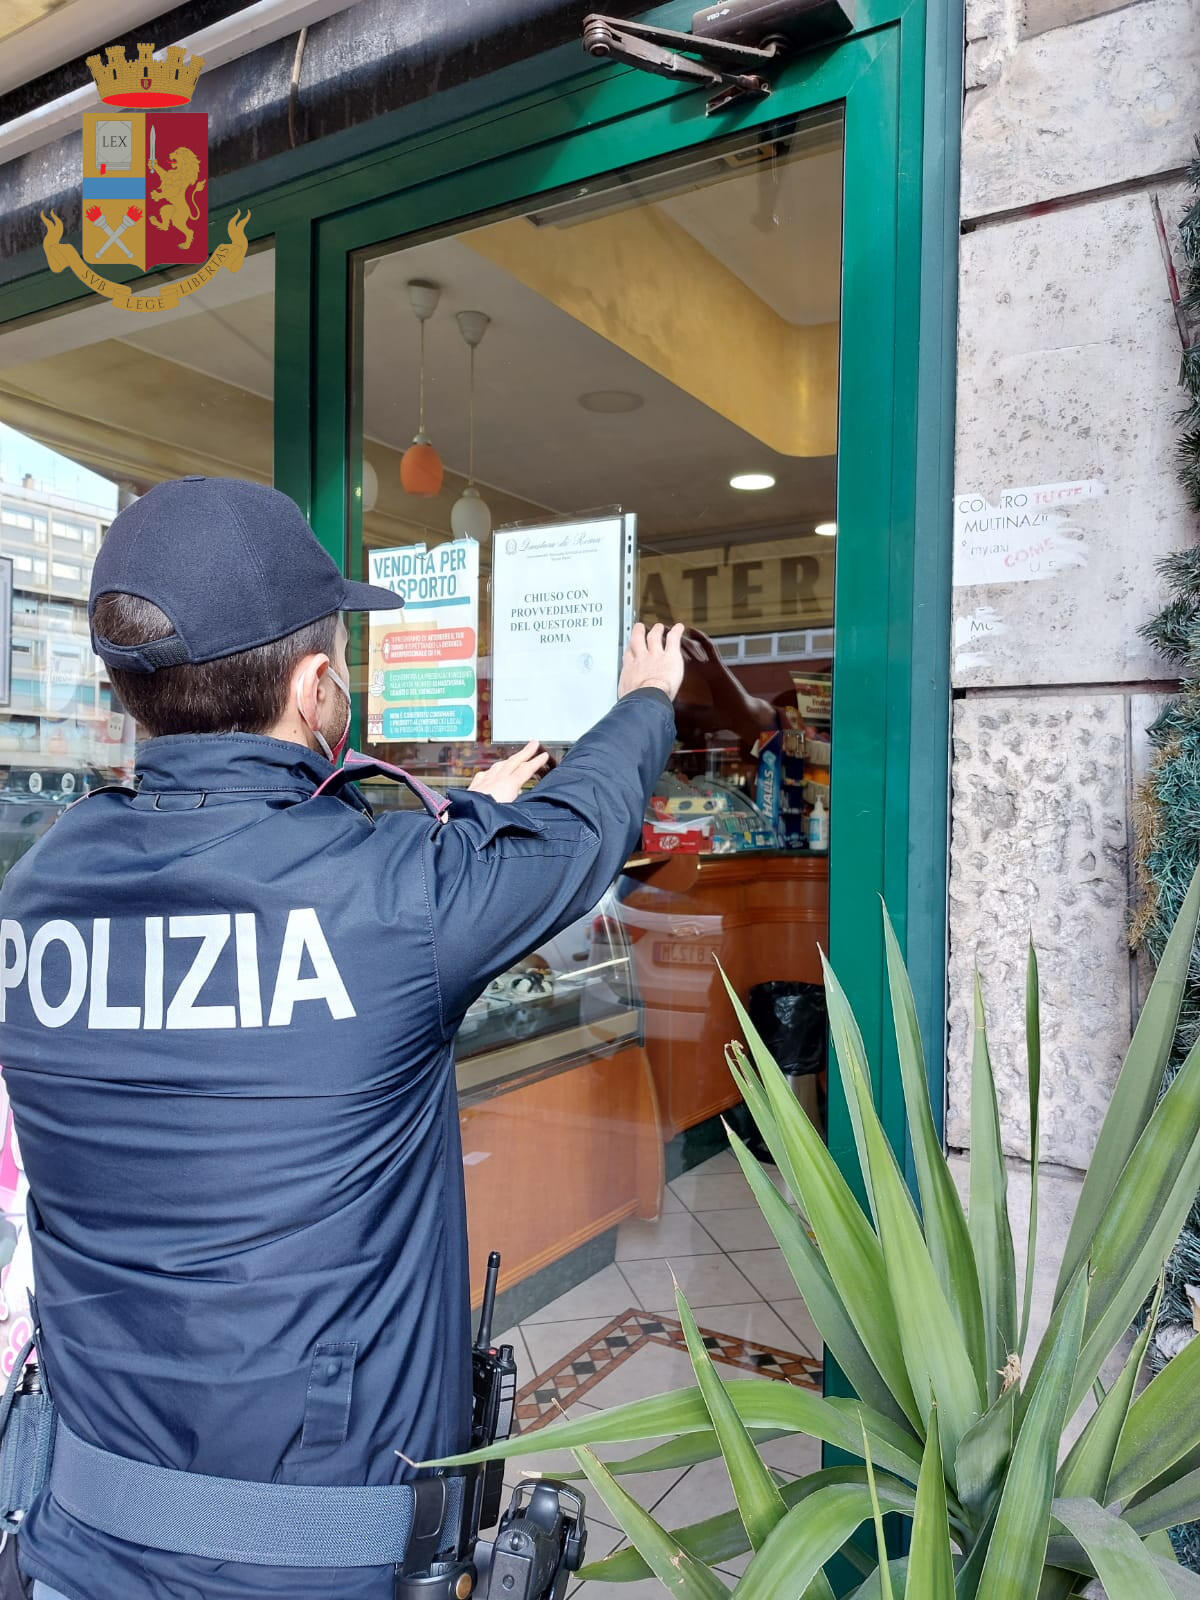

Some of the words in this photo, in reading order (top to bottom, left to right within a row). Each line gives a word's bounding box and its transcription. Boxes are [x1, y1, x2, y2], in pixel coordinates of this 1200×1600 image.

[374, 552, 436, 579] VENDITA
[440, 548, 467, 572] PER
[524, 591, 564, 603] CHIUSO
[566, 589, 589, 600] CON
[511, 602, 603, 618] PROVVEDIMENTO
[510, 621, 530, 632] DEL
[533, 617, 589, 632] QUESTORE
[591, 616, 603, 627] DI
[540, 633, 571, 644] ROMA
[762, 769, 774, 818] HALLS
[0, 907, 357, 1030] POLIZIA
